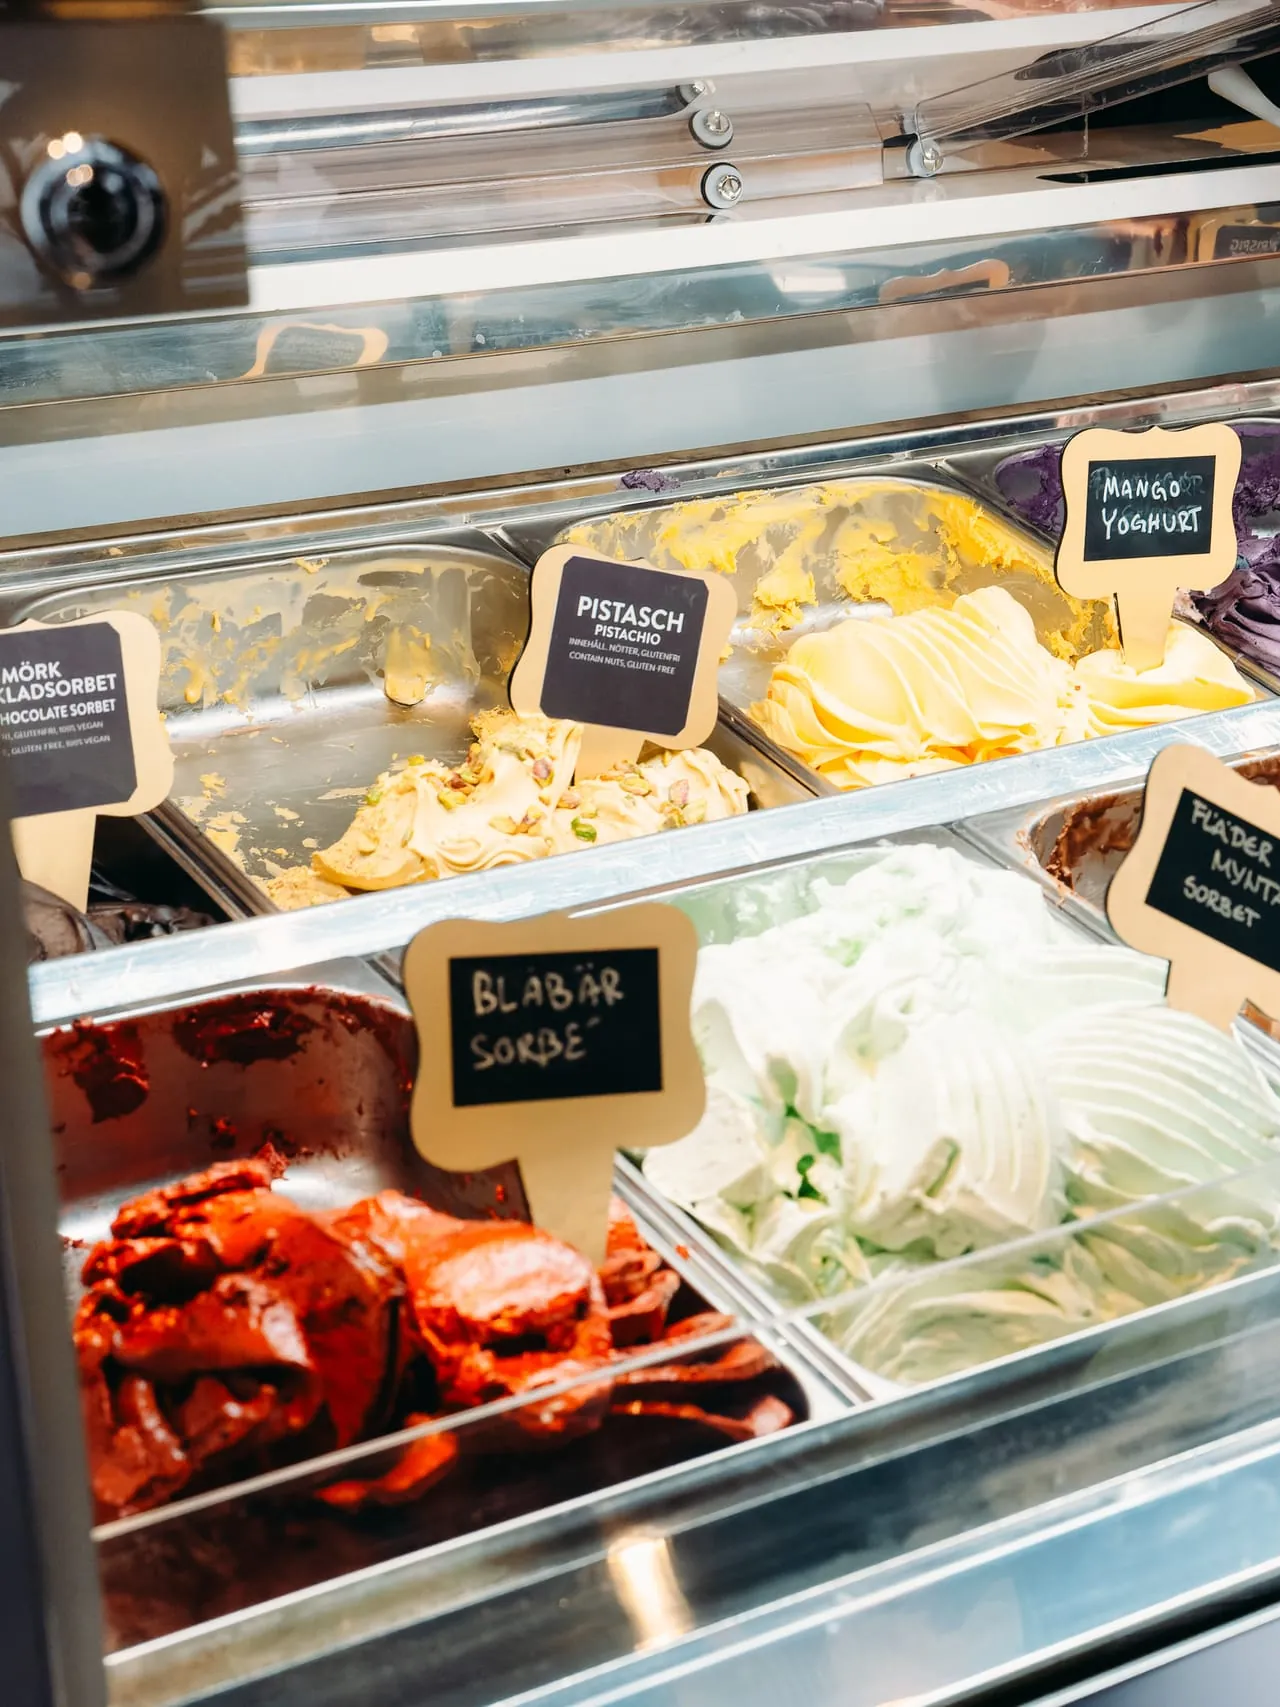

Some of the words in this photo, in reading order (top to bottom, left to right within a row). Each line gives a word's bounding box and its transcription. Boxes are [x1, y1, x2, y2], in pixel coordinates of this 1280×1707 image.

[1103, 475, 1181, 503] MANGO
[1101, 506, 1202, 540] YOGHURT
[577, 595, 685, 633] PISTASCH
[594, 624, 661, 645] PISTACHIO
[569, 651, 604, 663] CONTAIN
[604, 656, 626, 668] NUTS,
[640, 649, 680, 662] GLUTENFRI
[2, 661, 62, 684] MÖRK
[70, 699, 116, 717] SORBET
[76, 720, 103, 731] VEGAN
[11, 744, 42, 755] GLUTEN
[84, 735, 110, 745] VEGAN
[1191, 799, 1273, 868] FLÄDER
[1183, 875, 1261, 928] SORBET
